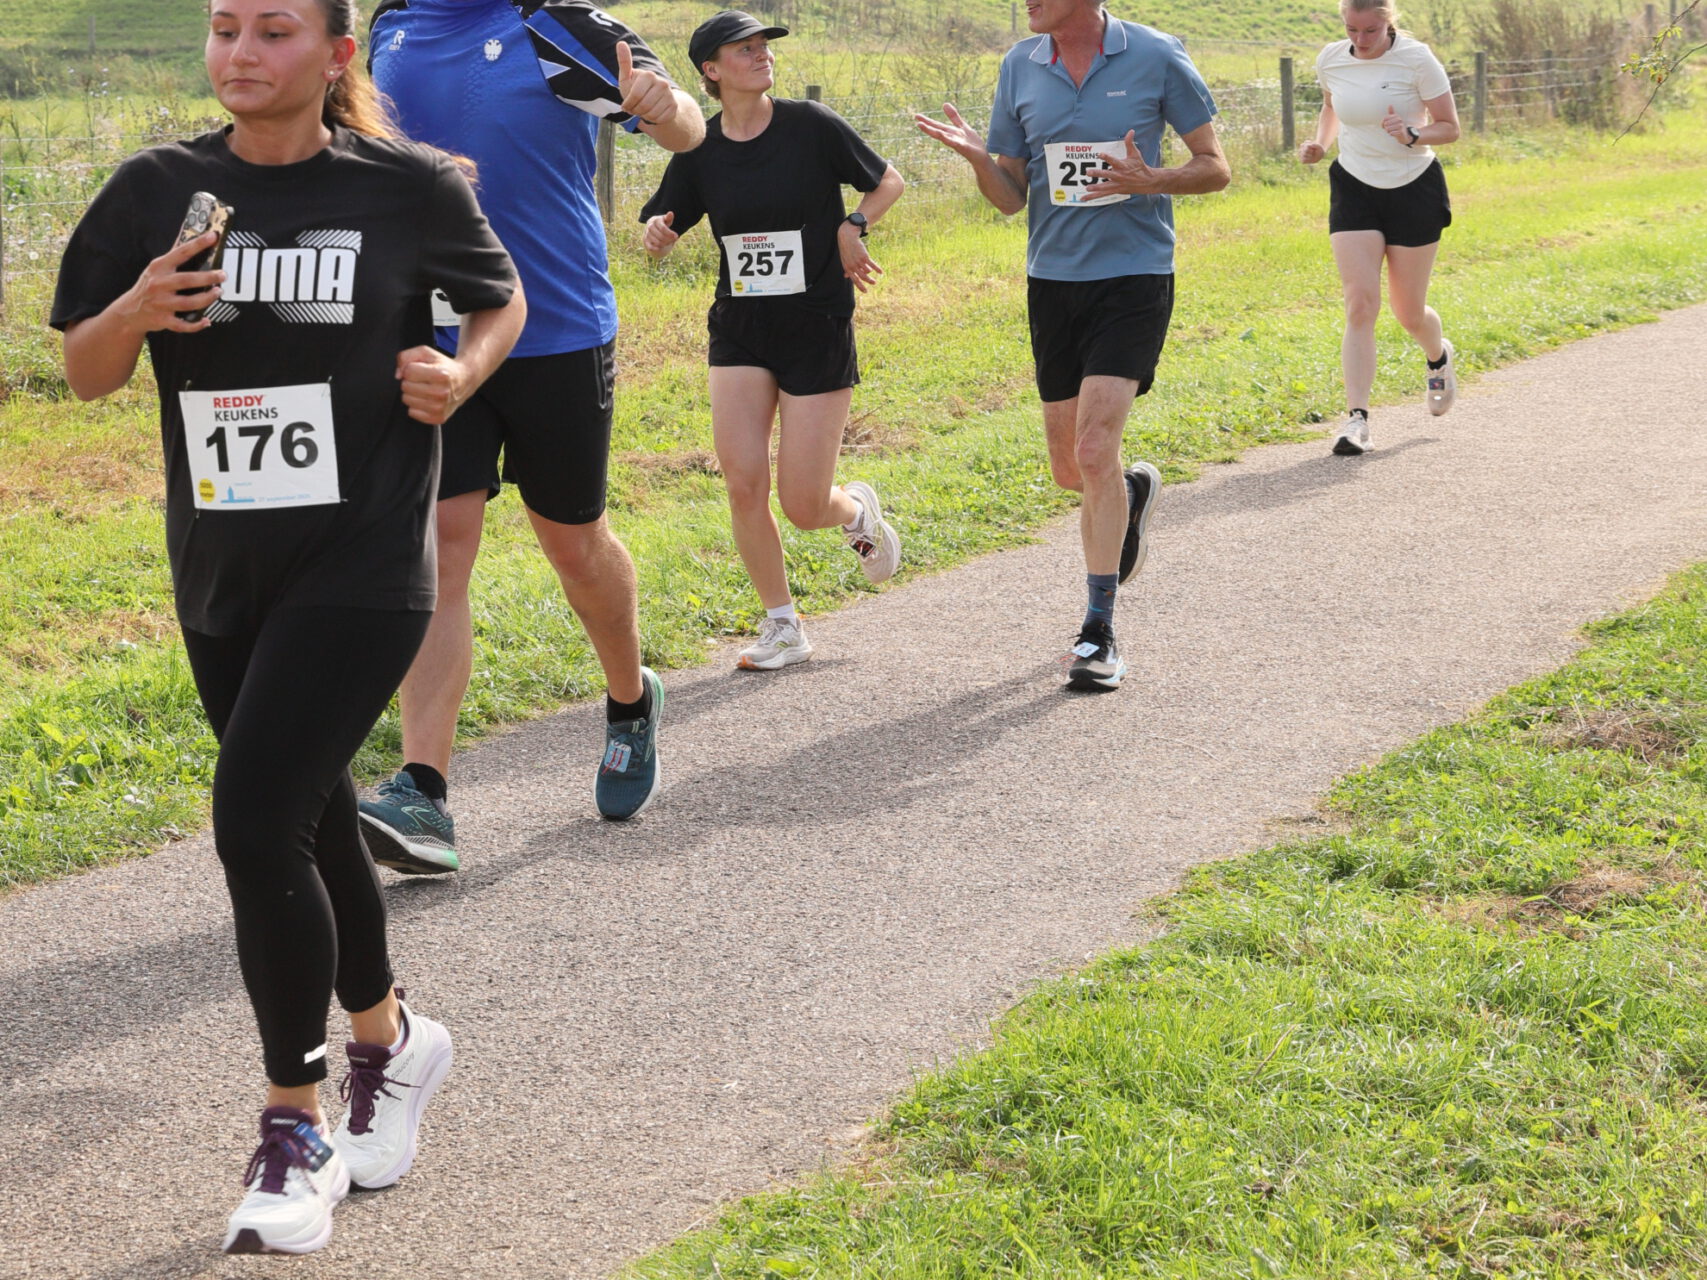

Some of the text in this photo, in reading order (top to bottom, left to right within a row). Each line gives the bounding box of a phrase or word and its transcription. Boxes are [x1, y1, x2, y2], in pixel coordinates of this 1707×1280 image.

[1066, 152, 1101, 160] KEUKENS
[742, 235, 768, 243] REDDY
[743, 242, 775, 250] KEUKENS
[737, 250, 794, 277] 257
[221, 247, 357, 302] UMA
[213, 394, 265, 408] REDDY
[214, 407, 279, 422] KEUKENS
[206, 421, 319, 473] 176
